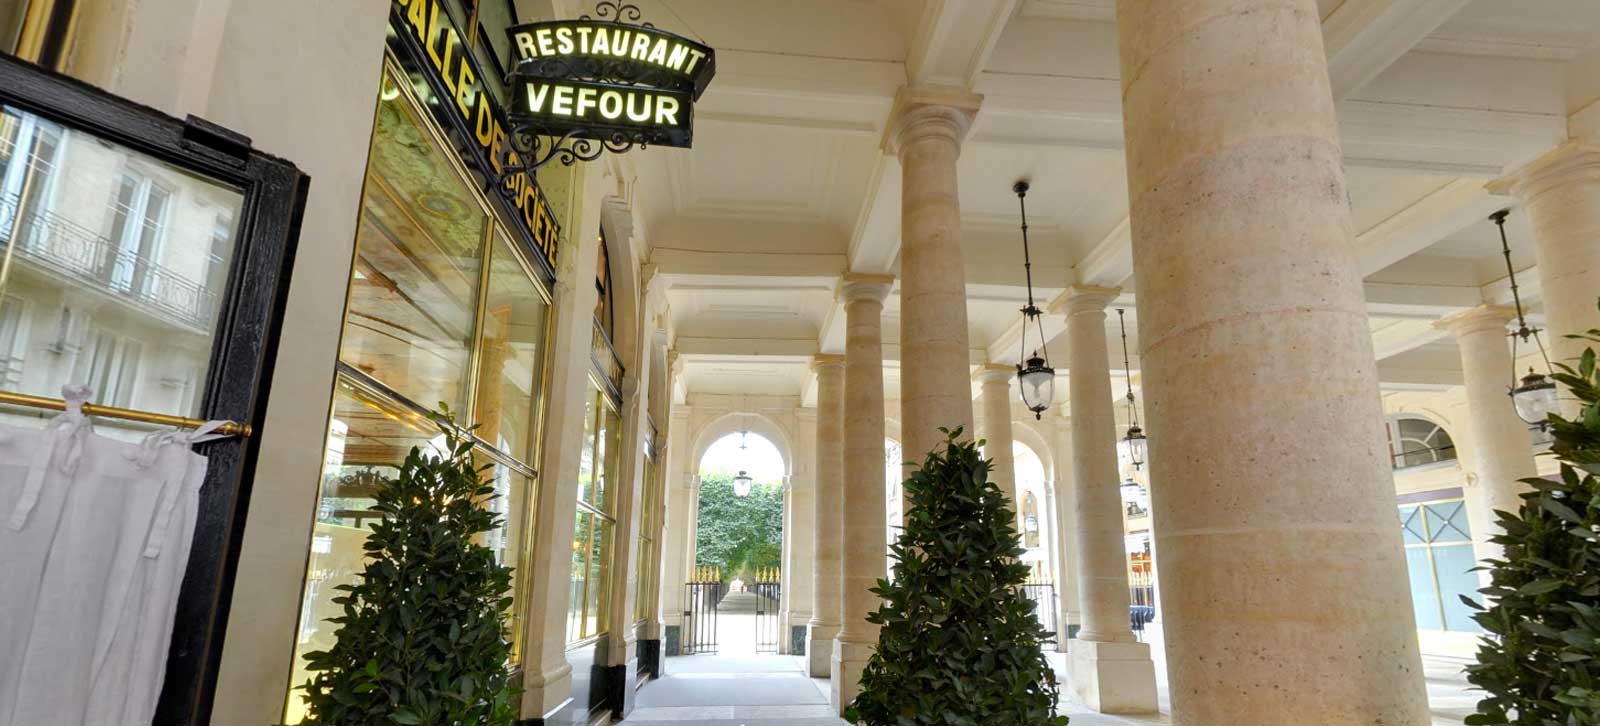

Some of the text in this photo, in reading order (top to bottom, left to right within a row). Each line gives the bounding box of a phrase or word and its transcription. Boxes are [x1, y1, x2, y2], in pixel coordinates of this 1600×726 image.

[515, 27, 706, 75] RESTAURANT
[398, 0, 475, 120] ALLE
[476, 91, 504, 174] DE
[526, 83, 680, 125] VEFOUR
